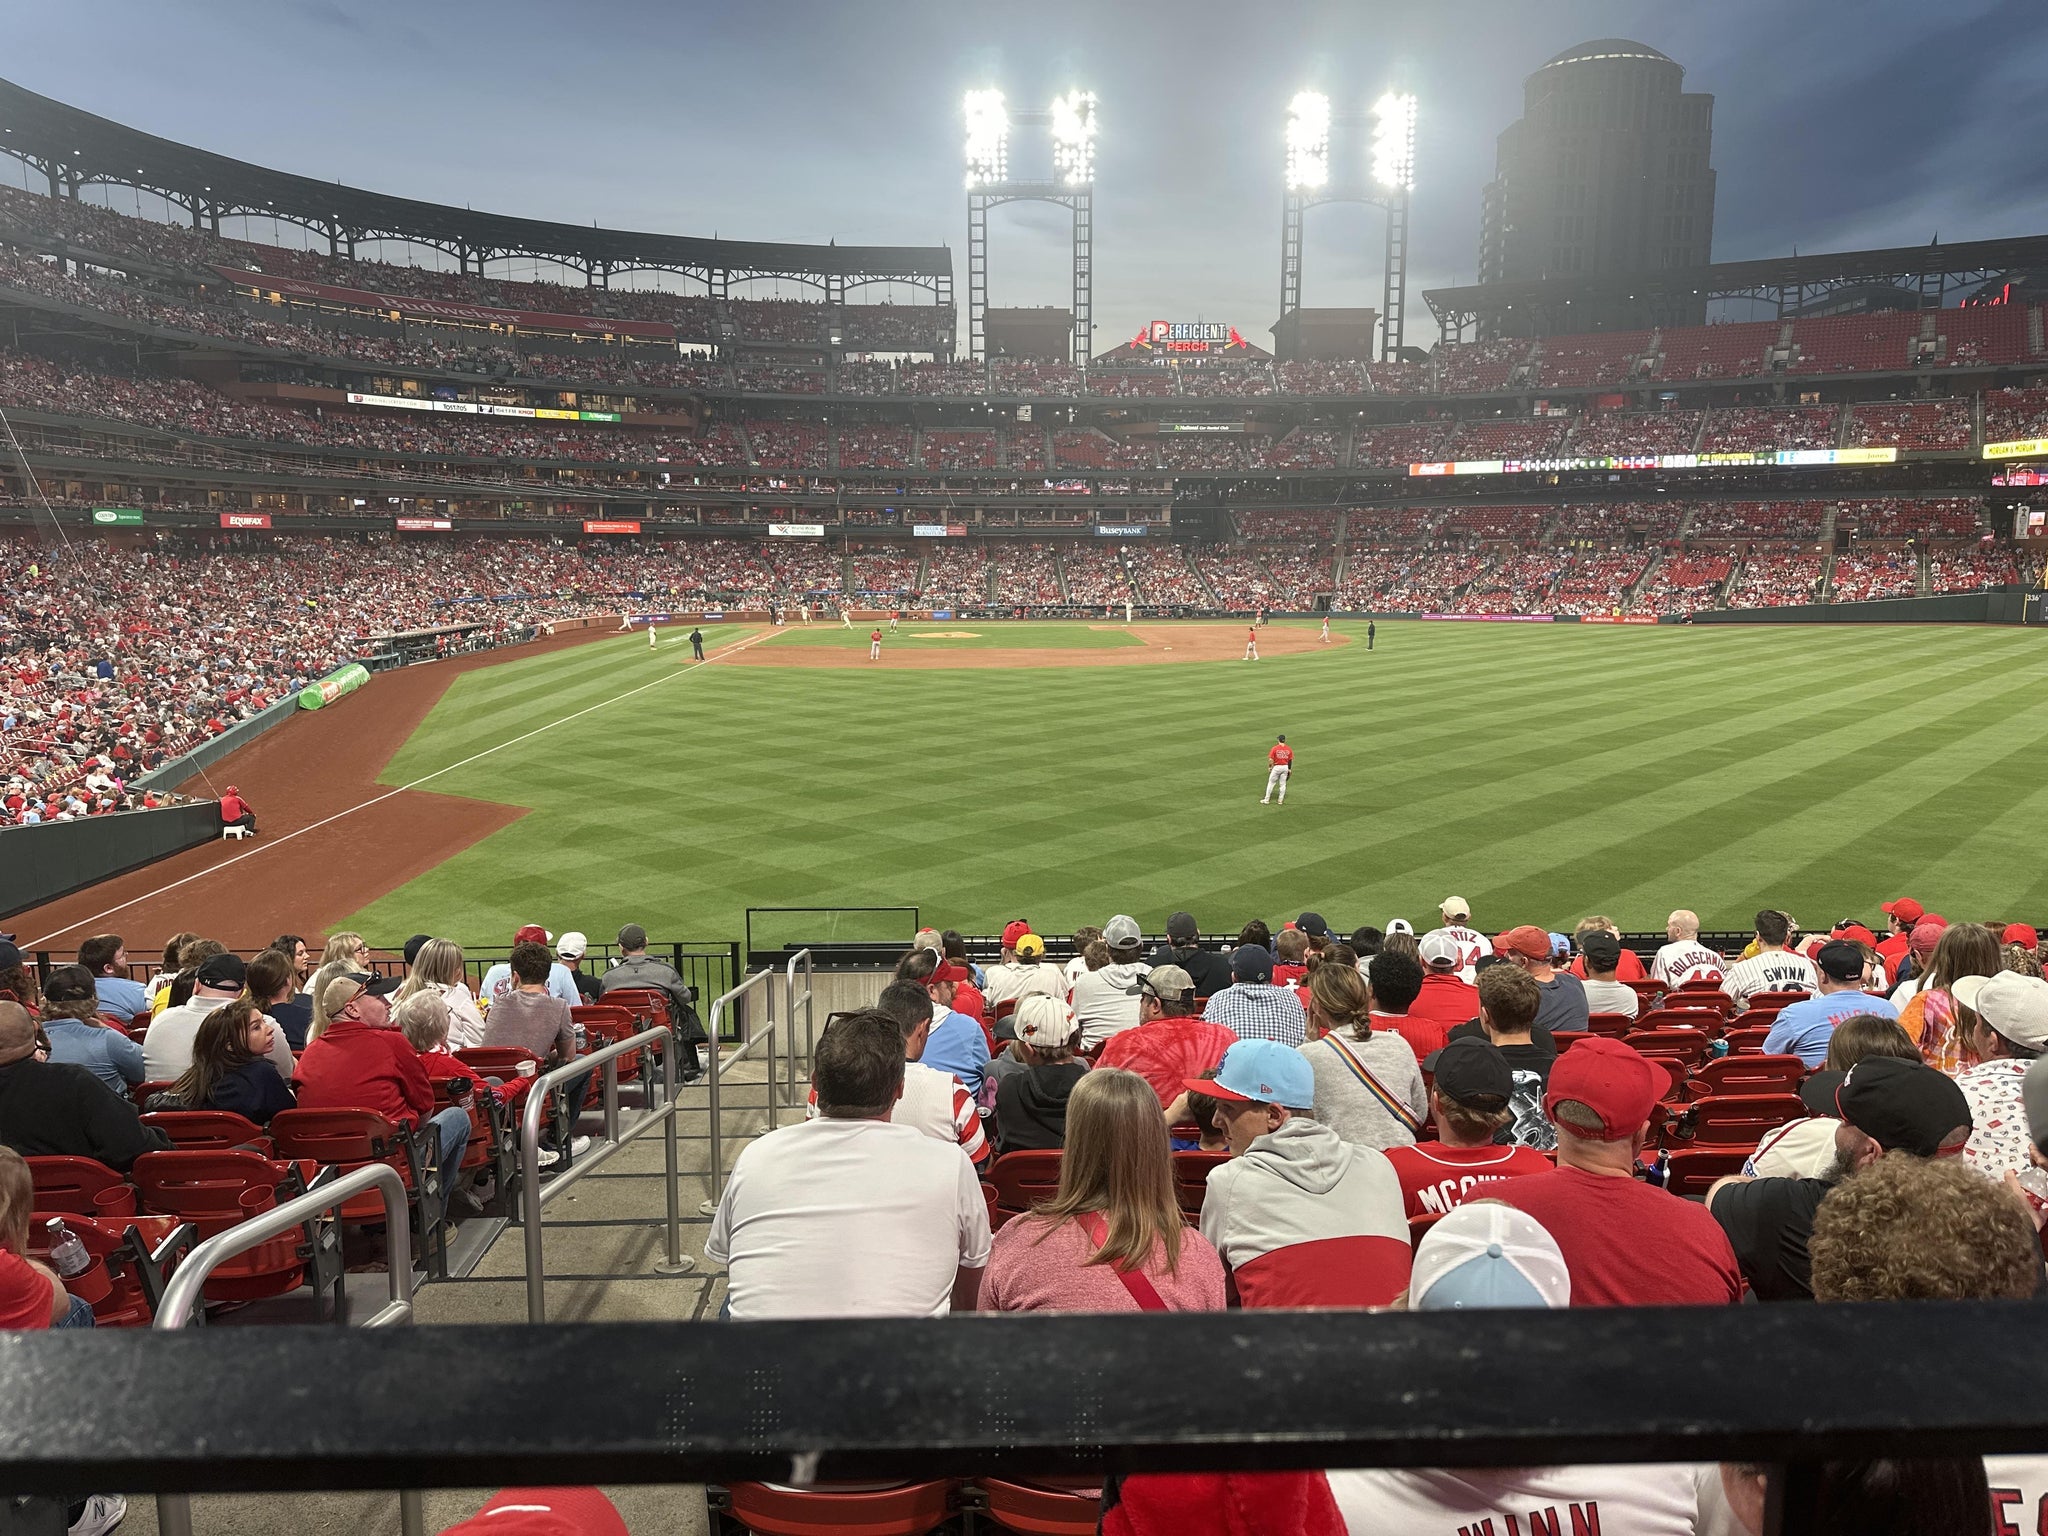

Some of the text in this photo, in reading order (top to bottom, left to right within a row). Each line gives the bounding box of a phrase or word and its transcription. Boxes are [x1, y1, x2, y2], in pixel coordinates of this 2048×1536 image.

[376, 296, 521, 323] Budweiser
[1151, 321, 1226, 343] PERFICIENT
[1167, 342, 1209, 352] PERCH
[229, 516, 264, 527] EQUIFAX
[1450, 931, 1477, 943] RTIZ
[1763, 966, 1806, 982] GWYNN
